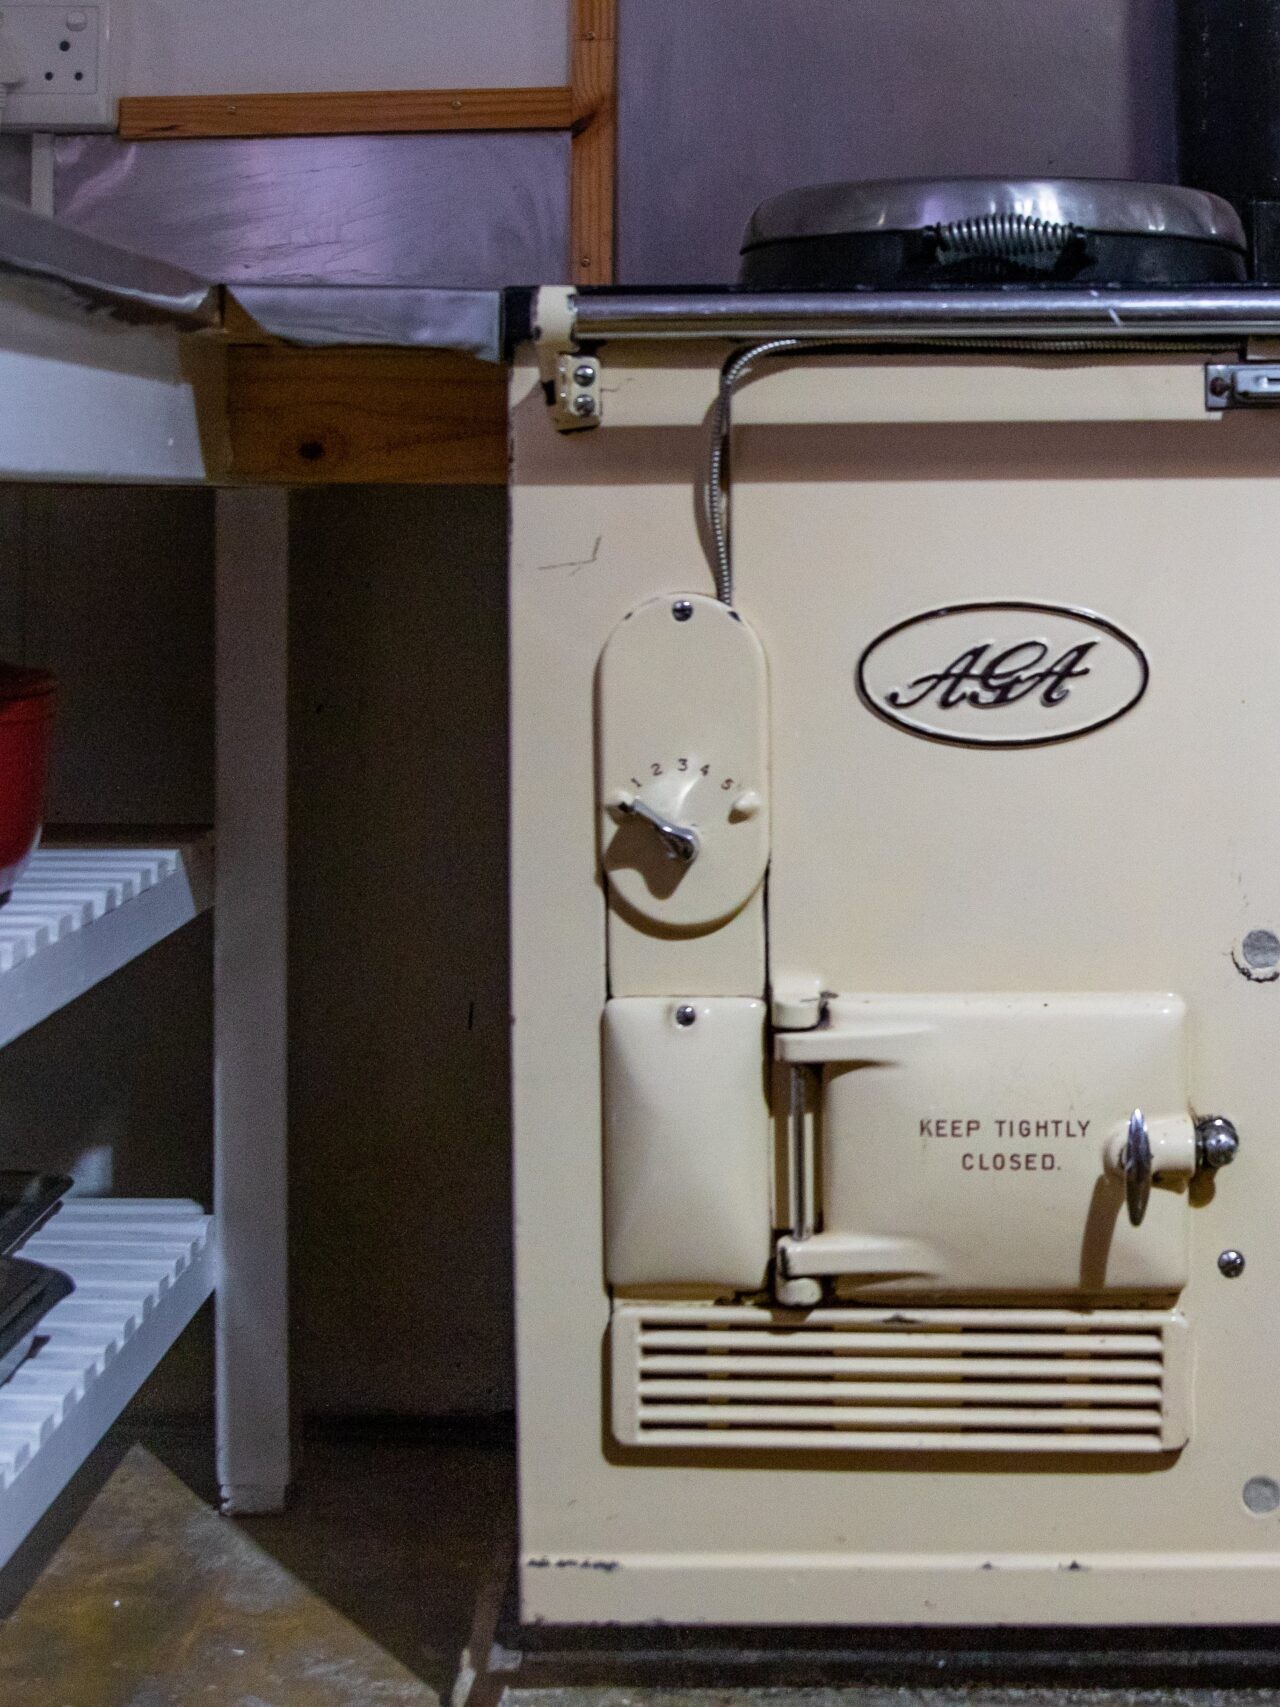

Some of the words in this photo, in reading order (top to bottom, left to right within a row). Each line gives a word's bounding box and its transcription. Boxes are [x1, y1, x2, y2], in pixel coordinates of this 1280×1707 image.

[886, 640, 1099, 708] AGA
[631, 777, 642, 788] 1
[651, 763, 663, 776] 2
[678, 758, 688, 772] 3
[700, 764, 710, 776] 4
[721, 778, 734, 790] 5
[919, 1119, 981, 1137] KEEP
[994, 1119, 1091, 1137] TIGHTLY
[961, 1153, 1061, 1171] CLOSED.
